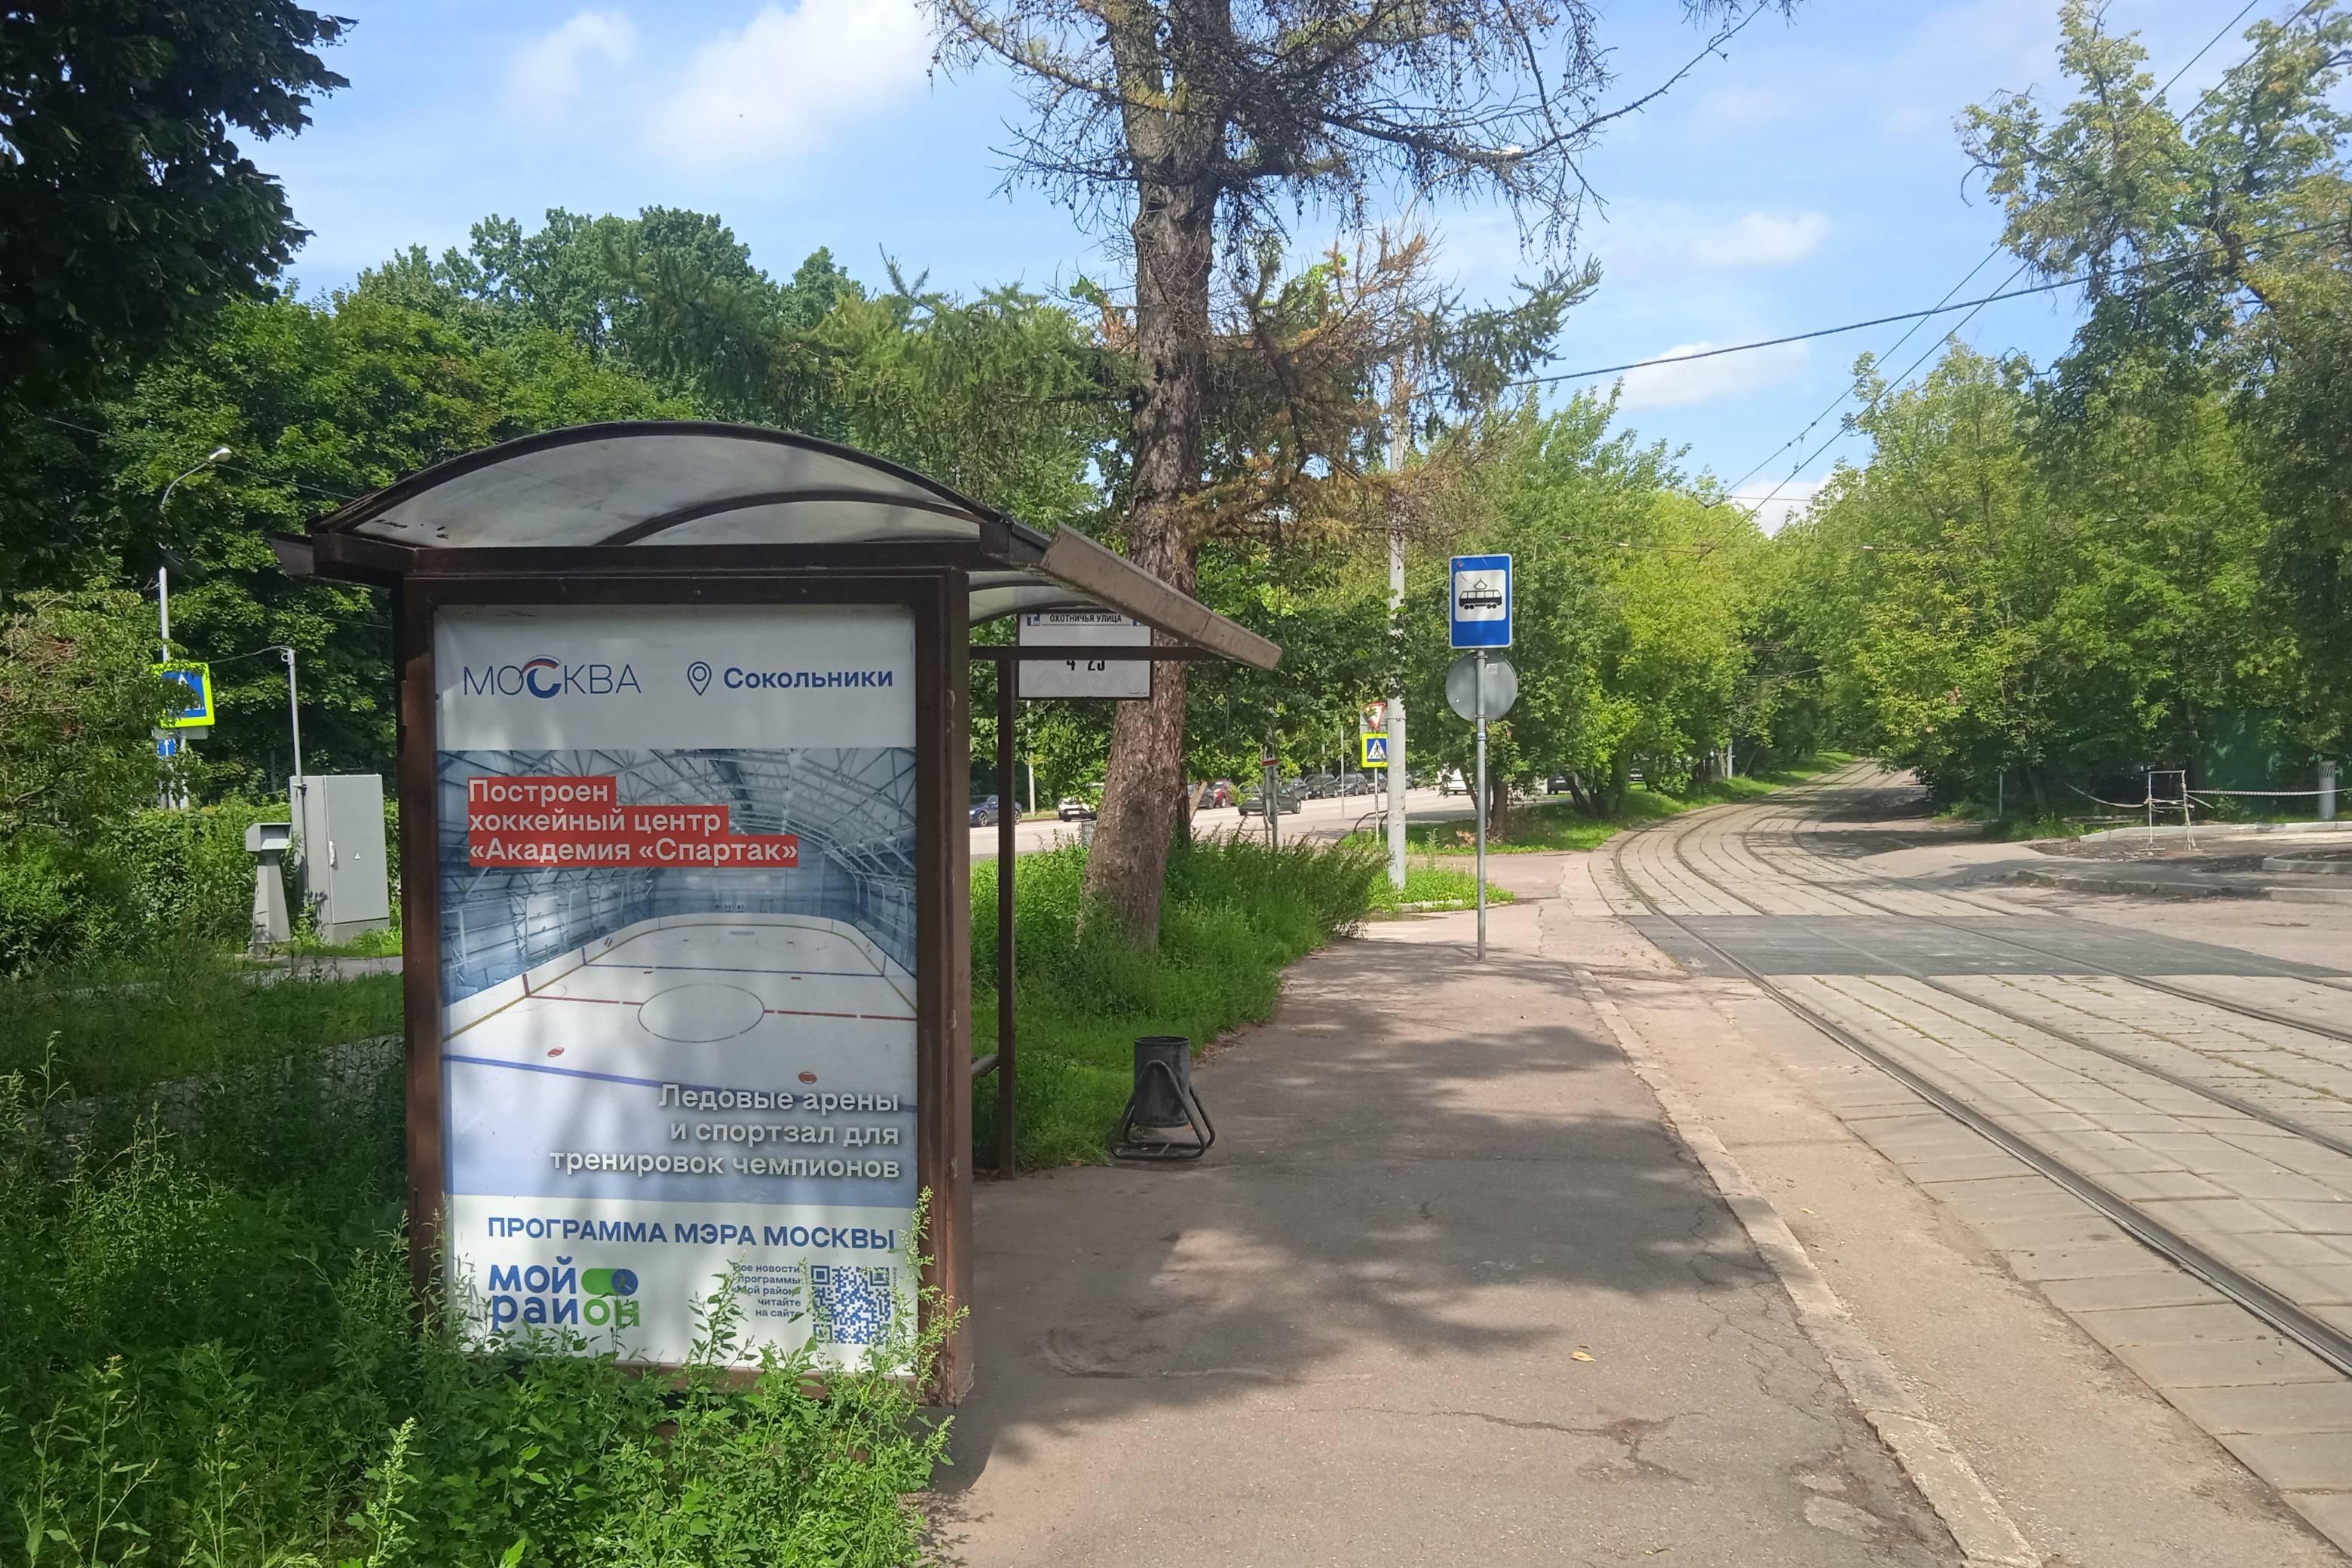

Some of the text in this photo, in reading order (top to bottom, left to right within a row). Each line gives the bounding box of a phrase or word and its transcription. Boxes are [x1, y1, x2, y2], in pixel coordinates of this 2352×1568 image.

[1049, 614, 1122, 623] ОХОТНИЧЬЯ УЛИЦА
[464, 655, 642, 699] МОСКВА
[724, 667, 893, 689] Сокольники
[469, 779, 608, 805] Построен
[469, 807, 721, 836] хоккейный центр
[470, 838, 798, 866] «Академия «Спартак»
[659, 1084, 899, 1119] Ледовые арены
[670, 1121, 899, 1149] и спортзал для
[550, 1150, 900, 1179] тренировок чемпионов
[488, 1217, 895, 1251] ПРОГРАММА МЭРА МОСКВЫ
